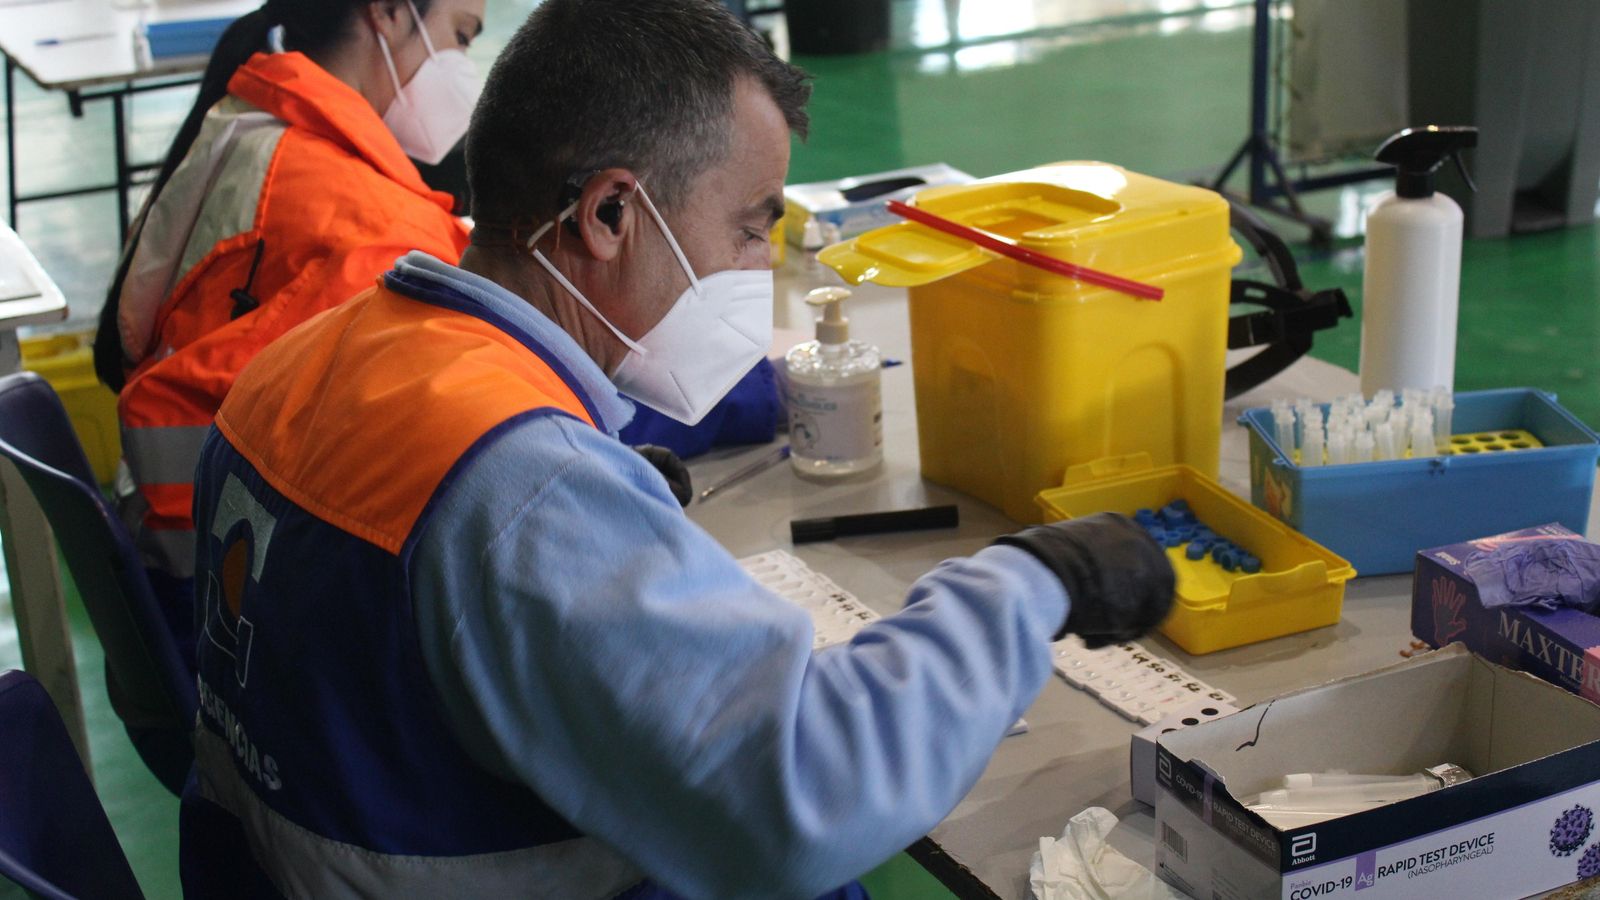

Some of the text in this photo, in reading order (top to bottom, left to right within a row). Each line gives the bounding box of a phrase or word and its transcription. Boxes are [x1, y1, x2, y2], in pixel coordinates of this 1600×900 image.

[1290, 832, 1495, 900] COVID-19 Ag RAPID TEST DEVICE
[1291, 854, 1316, 866] Abbott
[1407, 844, 1494, 879] (NASOPHARYNGEAL)
